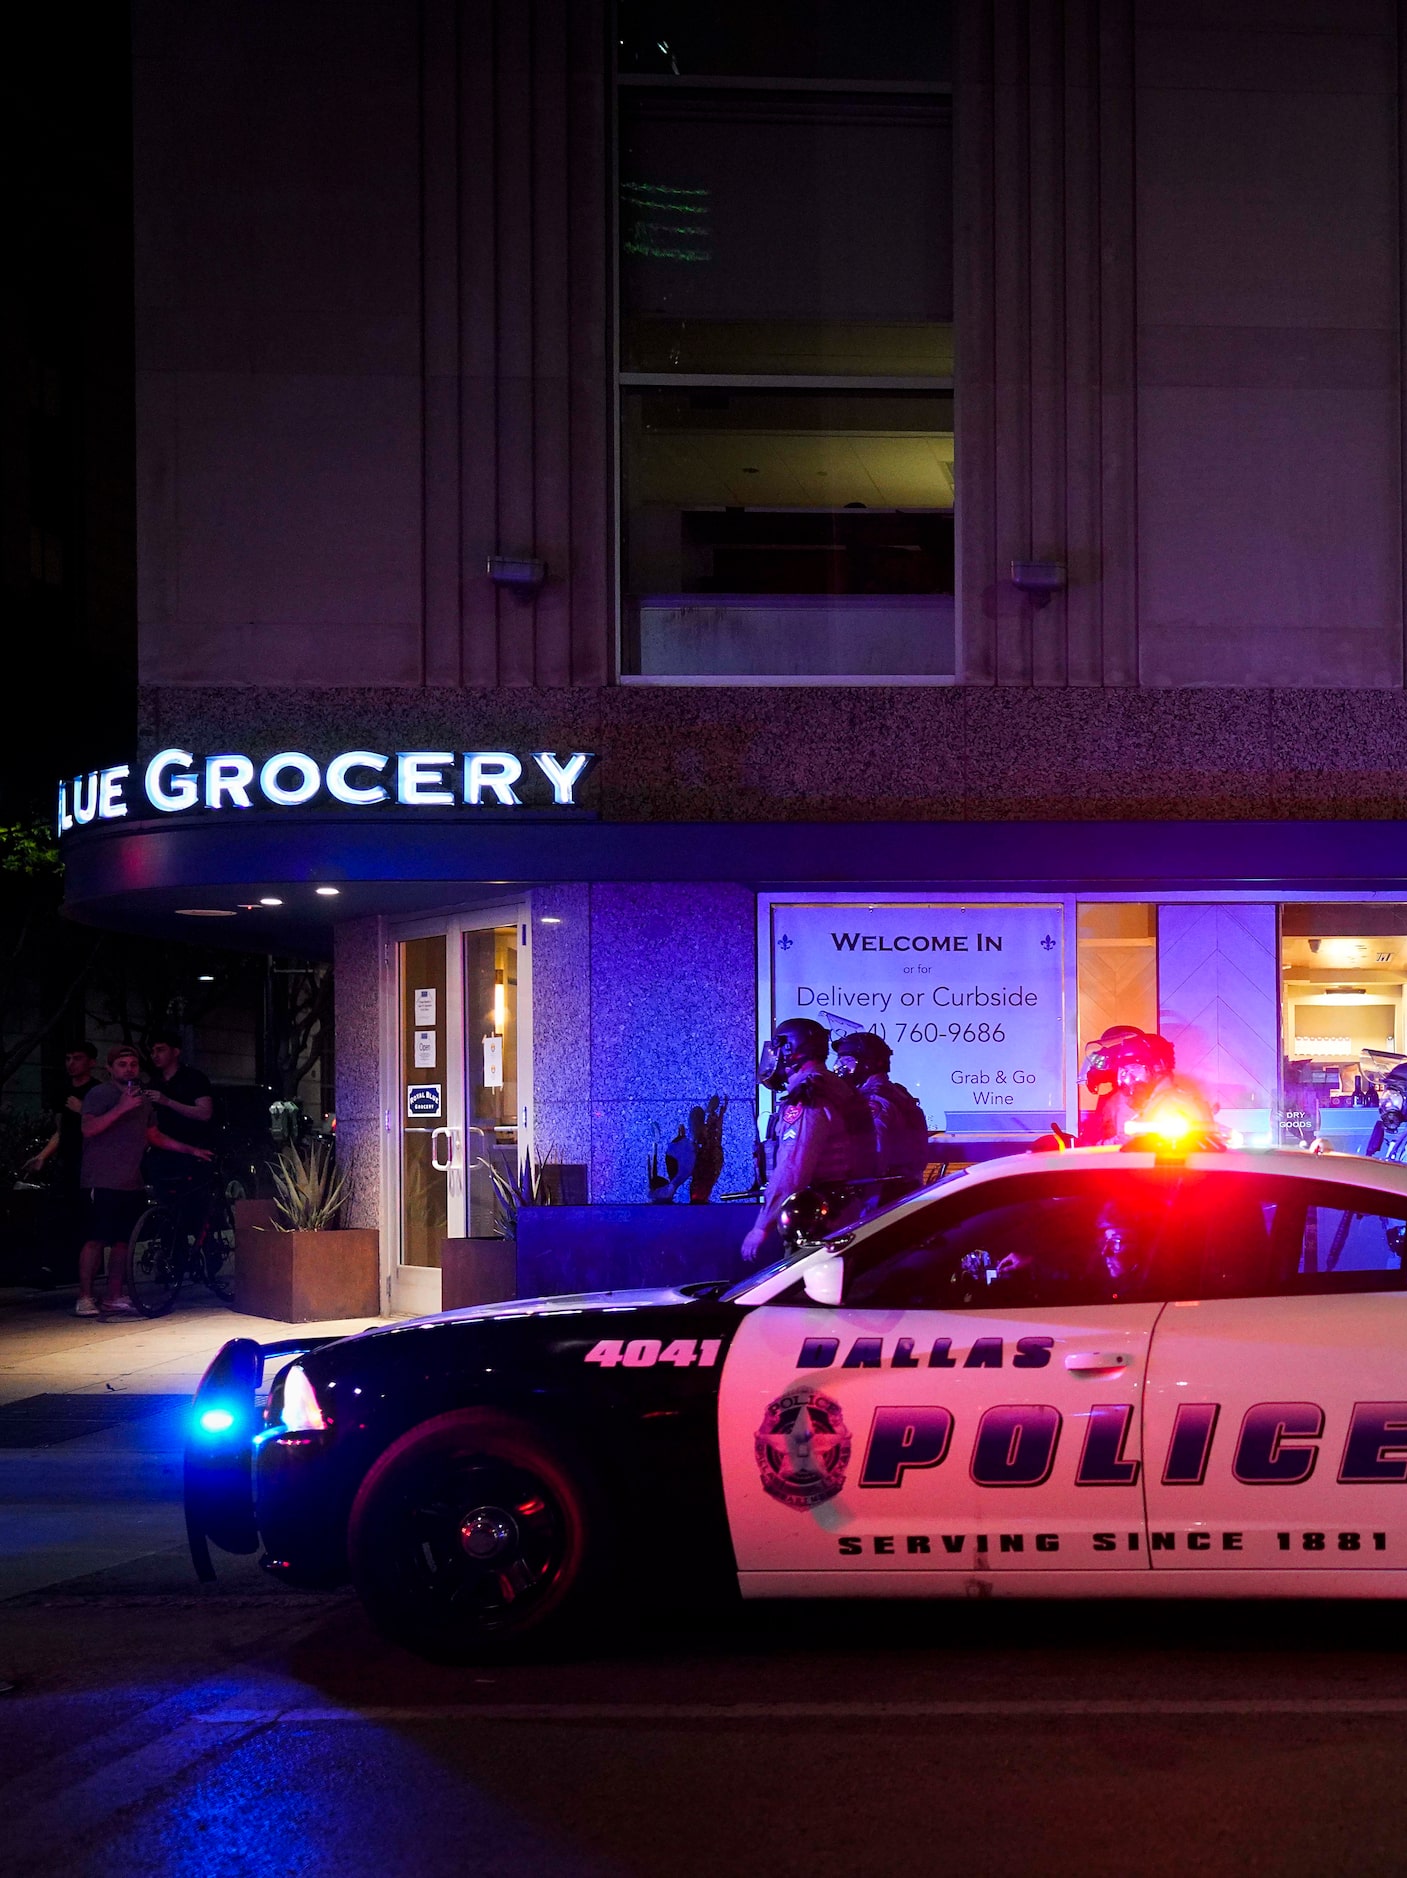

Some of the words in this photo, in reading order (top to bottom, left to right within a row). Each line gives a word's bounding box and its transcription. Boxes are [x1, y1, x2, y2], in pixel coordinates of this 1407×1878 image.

[145, 747, 595, 813] GROCERY
[831, 932, 968, 952] WELCOME
[977, 932, 1003, 952] IN
[903, 966, 914, 974] or
[917, 964, 933, 974] for
[797, 986, 892, 1012] Delivery
[900, 990, 925, 1007] or
[932, 986, 1038, 1007] Curbside
[895, 1022, 1006, 1043] 760-9686
[951, 1069, 990, 1085] Grab
[995, 1070, 1007, 1085] &
[1012, 1069, 1036, 1085] Go
[973, 1091, 1014, 1106] Wine
[1286, 1111, 1305, 1119] DRY
[584, 1340, 720, 1368] 4041
[796, 1337, 1055, 1370] DALLAS
[838, 1533, 1061, 1557] SERVING
[1092, 1531, 1245, 1554] SINCE
[1276, 1530, 1389, 1553] 1881
